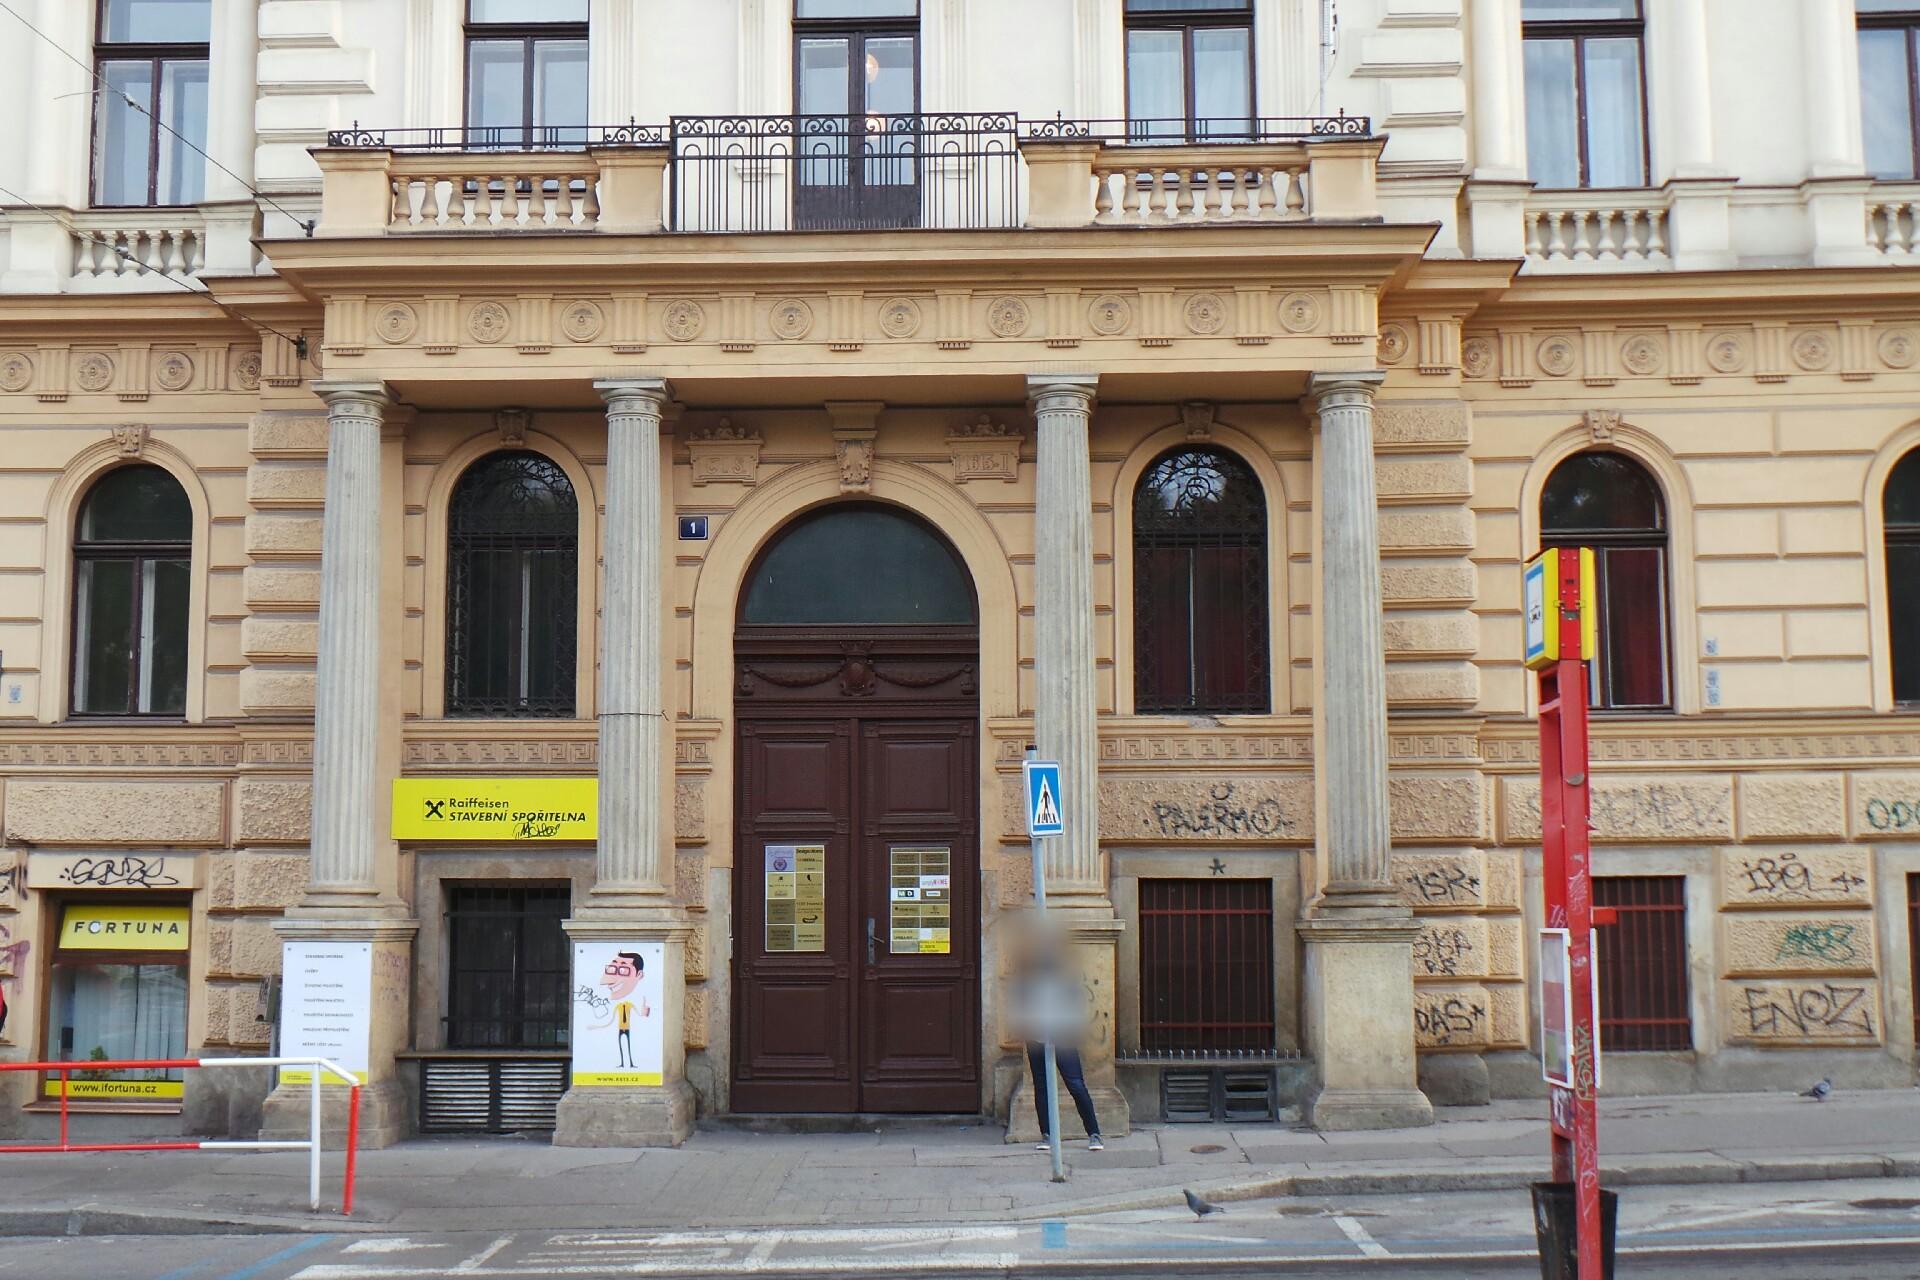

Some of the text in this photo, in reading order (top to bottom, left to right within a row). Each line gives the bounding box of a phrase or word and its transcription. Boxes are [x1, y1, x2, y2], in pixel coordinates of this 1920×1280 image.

[690, 521, 696, 534] 1
[449, 798, 509, 809] Raiffeisen
[449, 809, 586, 822] STAVEBNÍ SPOŘITELNA
[74, 920, 180, 935] FORTUNA
[72, 1082, 157, 1096] www.ifortuna.cz
